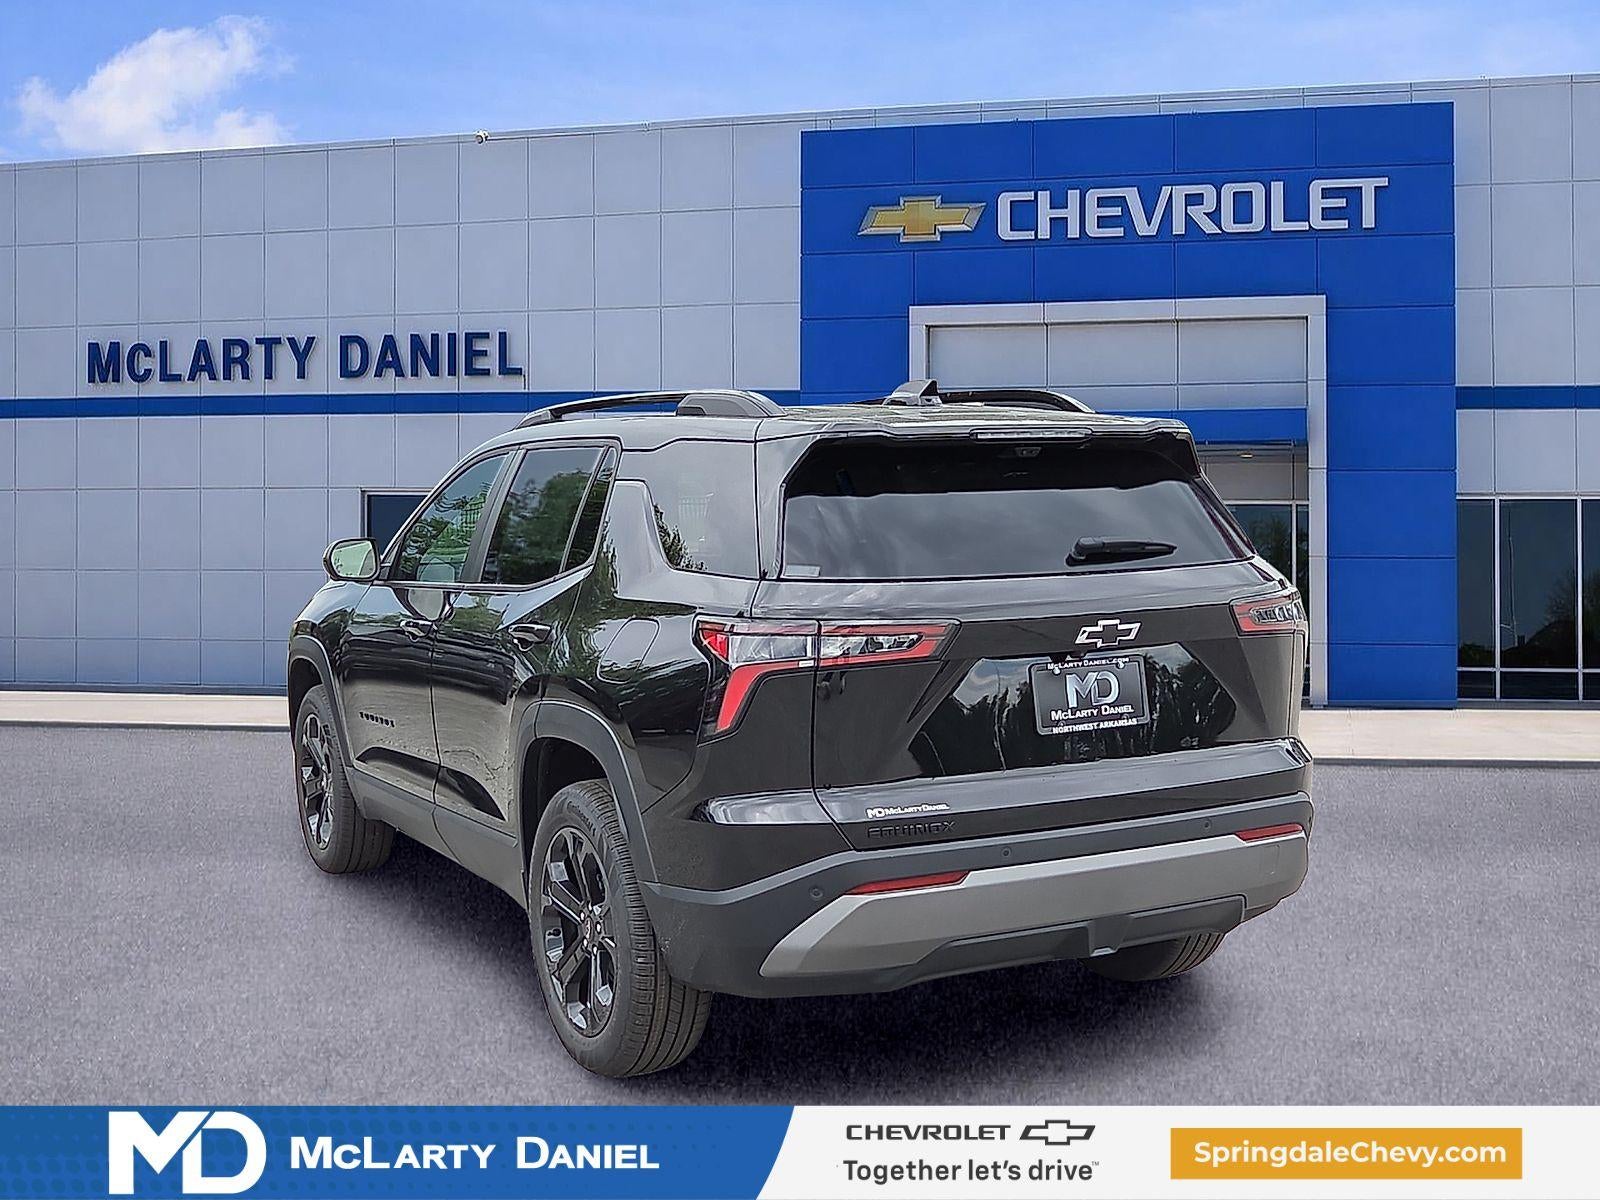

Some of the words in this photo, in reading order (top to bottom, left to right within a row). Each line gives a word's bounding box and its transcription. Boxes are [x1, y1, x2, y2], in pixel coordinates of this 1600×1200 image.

[997, 176, 1389, 241] CHEVROLET
[338, 331, 524, 379] DANIEL
[1065, 670, 1119, 708] MD
[1101, 704, 1135, 716] DANIEL
[1052, 722, 1098, 735] NORTHWEST
[1099, 718, 1138, 730] ARKANSAS
[867, 820, 956, 838] EQUINOX
